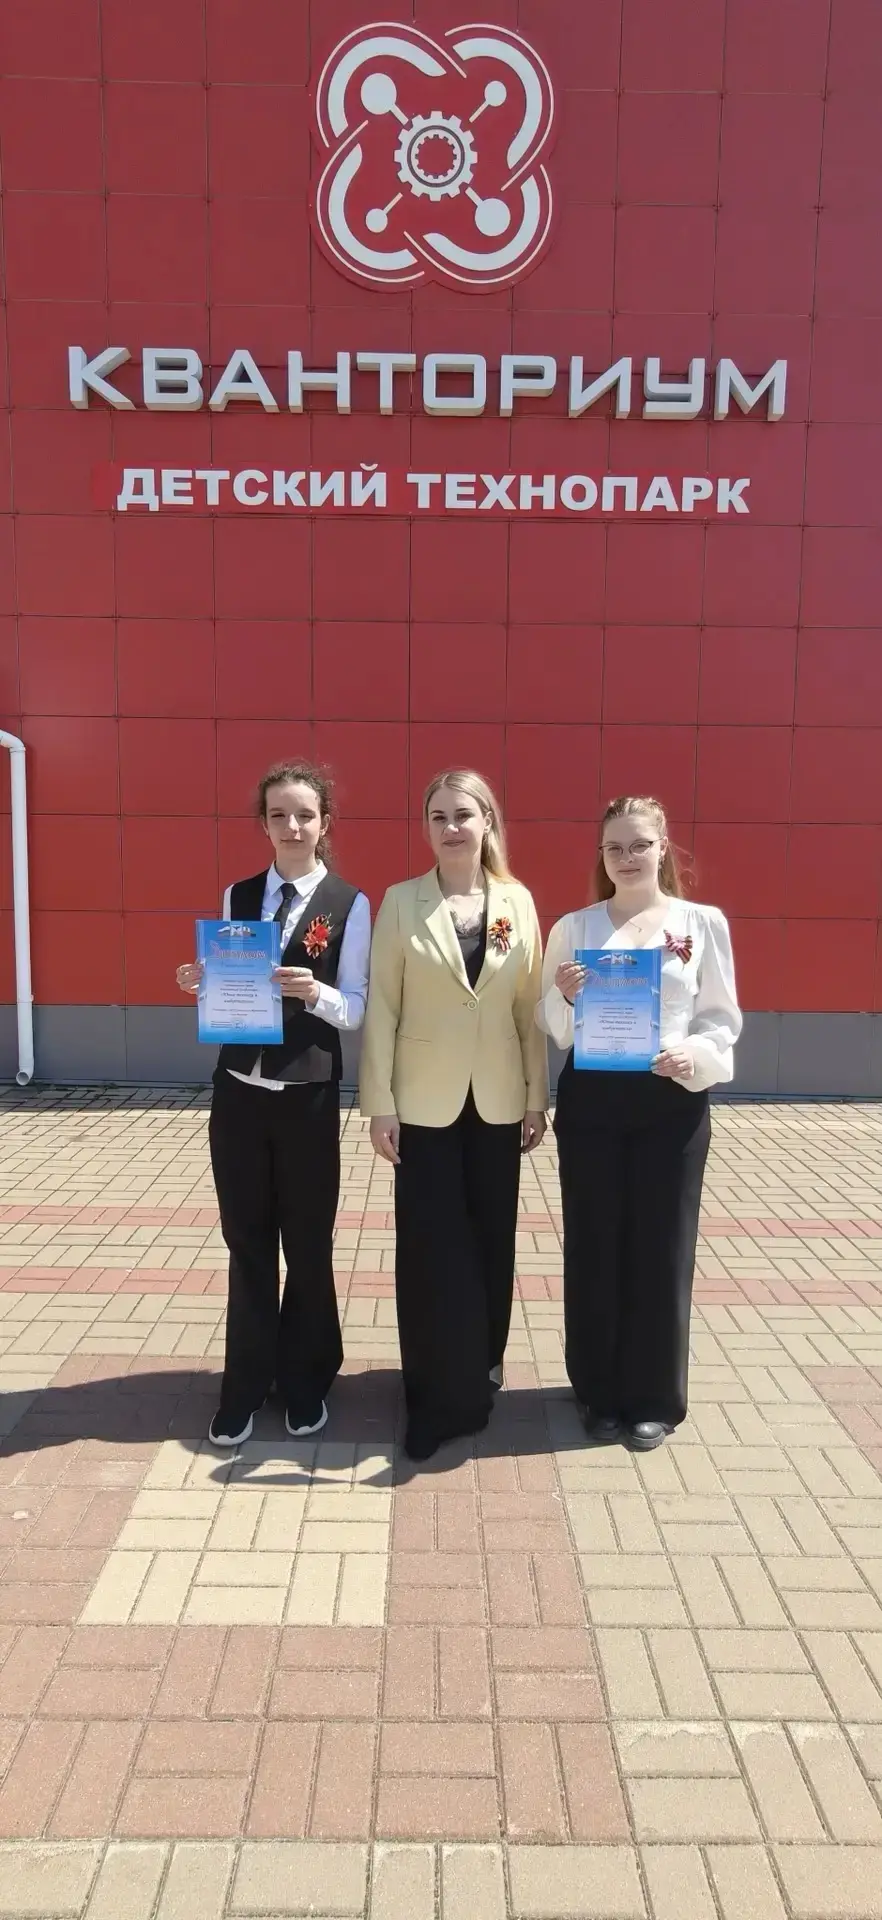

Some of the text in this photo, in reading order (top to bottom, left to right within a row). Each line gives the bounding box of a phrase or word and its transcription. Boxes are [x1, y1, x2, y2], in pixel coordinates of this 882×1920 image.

[68, 346, 788, 422] КВАНТОРИУМ
[117, 463, 750, 514] ДЕТСКИЙ ТЕХНОПАРК
